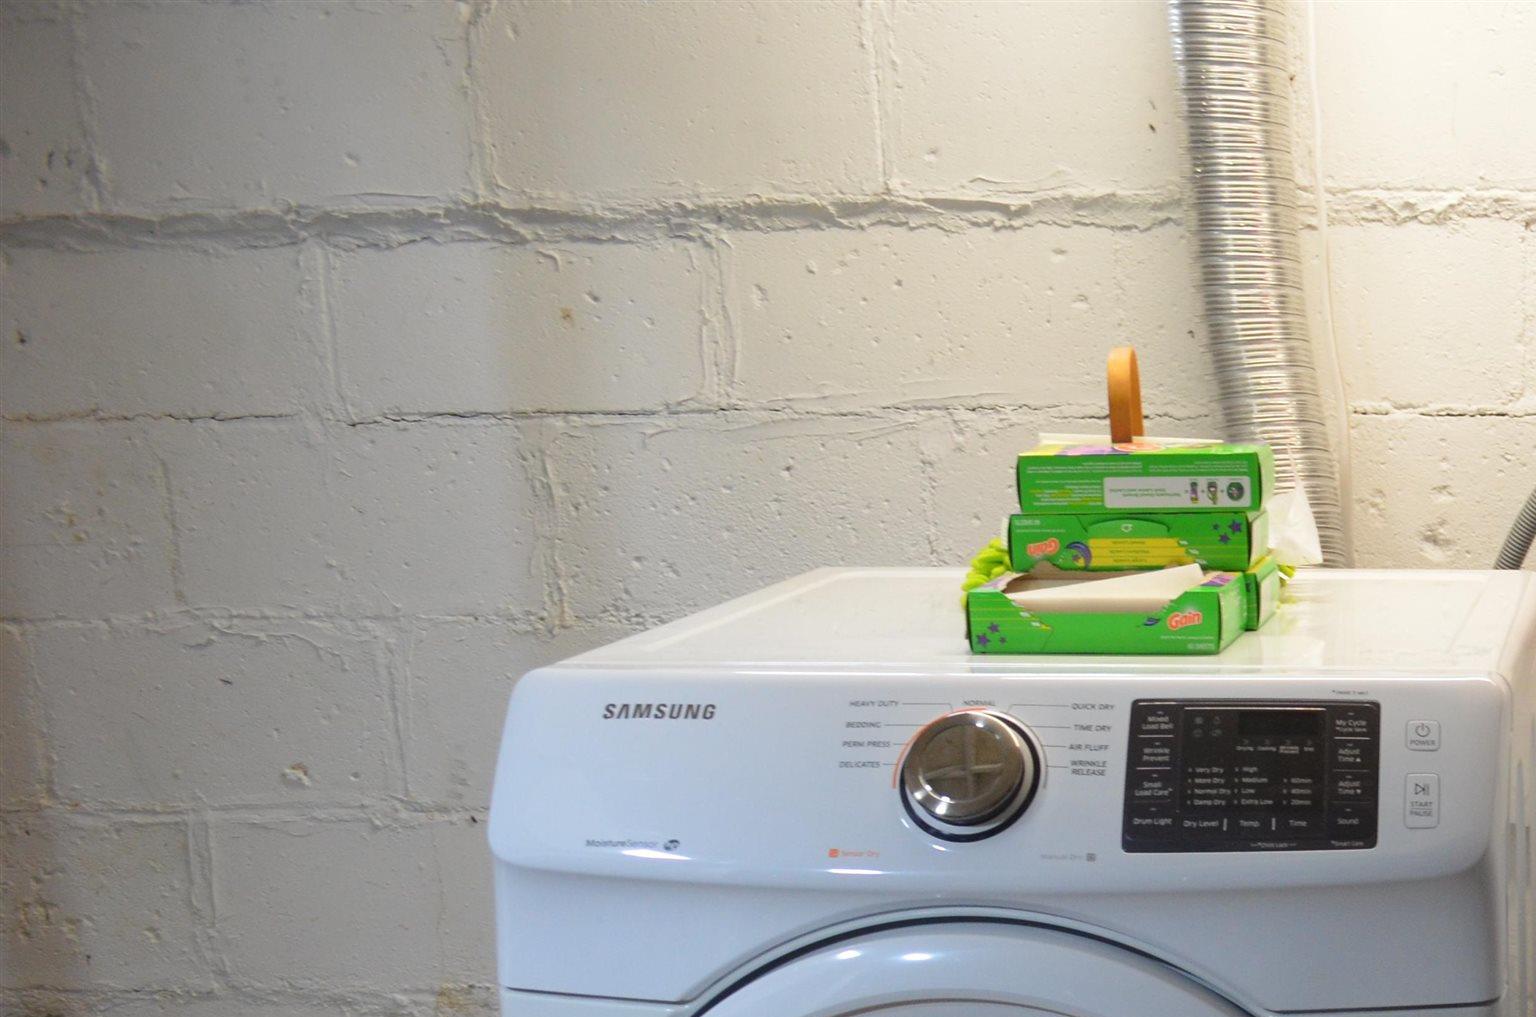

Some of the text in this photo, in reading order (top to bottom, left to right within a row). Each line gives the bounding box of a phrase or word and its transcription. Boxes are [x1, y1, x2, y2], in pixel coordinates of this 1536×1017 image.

[1167, 611, 1202, 629] Gain
[1098, 703, 1115, 711] DRY
[602, 703, 716, 720] SAMSUNG
[1409, 810, 1433, 818] PAUSE
[1152, 818, 1172, 826] Light
[1183, 819, 1198, 828] Dry
